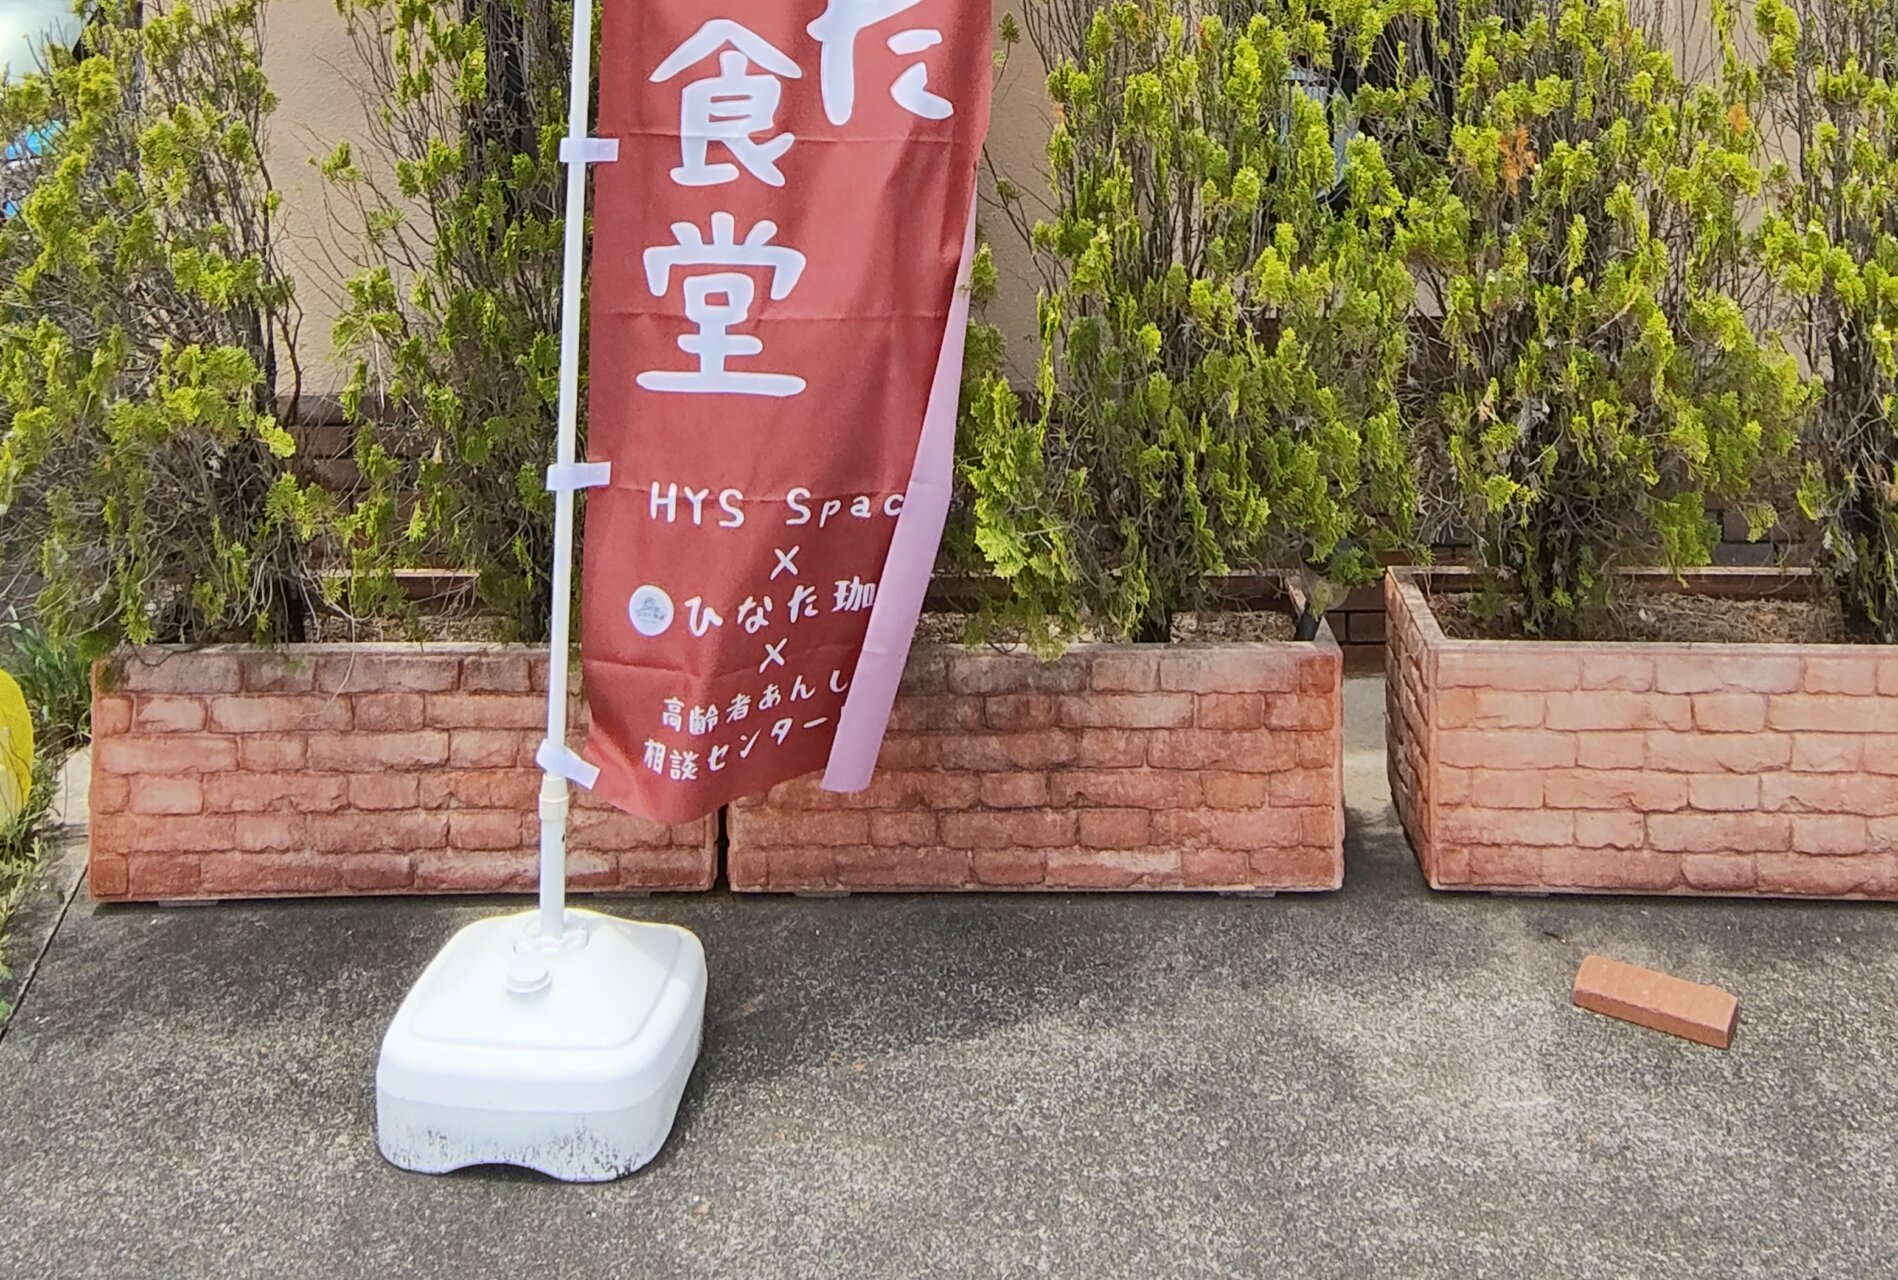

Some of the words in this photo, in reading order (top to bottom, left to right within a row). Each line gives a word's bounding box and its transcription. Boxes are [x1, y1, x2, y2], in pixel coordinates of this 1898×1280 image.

[635, 18, 807, 397] 食堂
[650, 481, 746, 529] HYS
[643, 717, 829, 781] 相談センター
